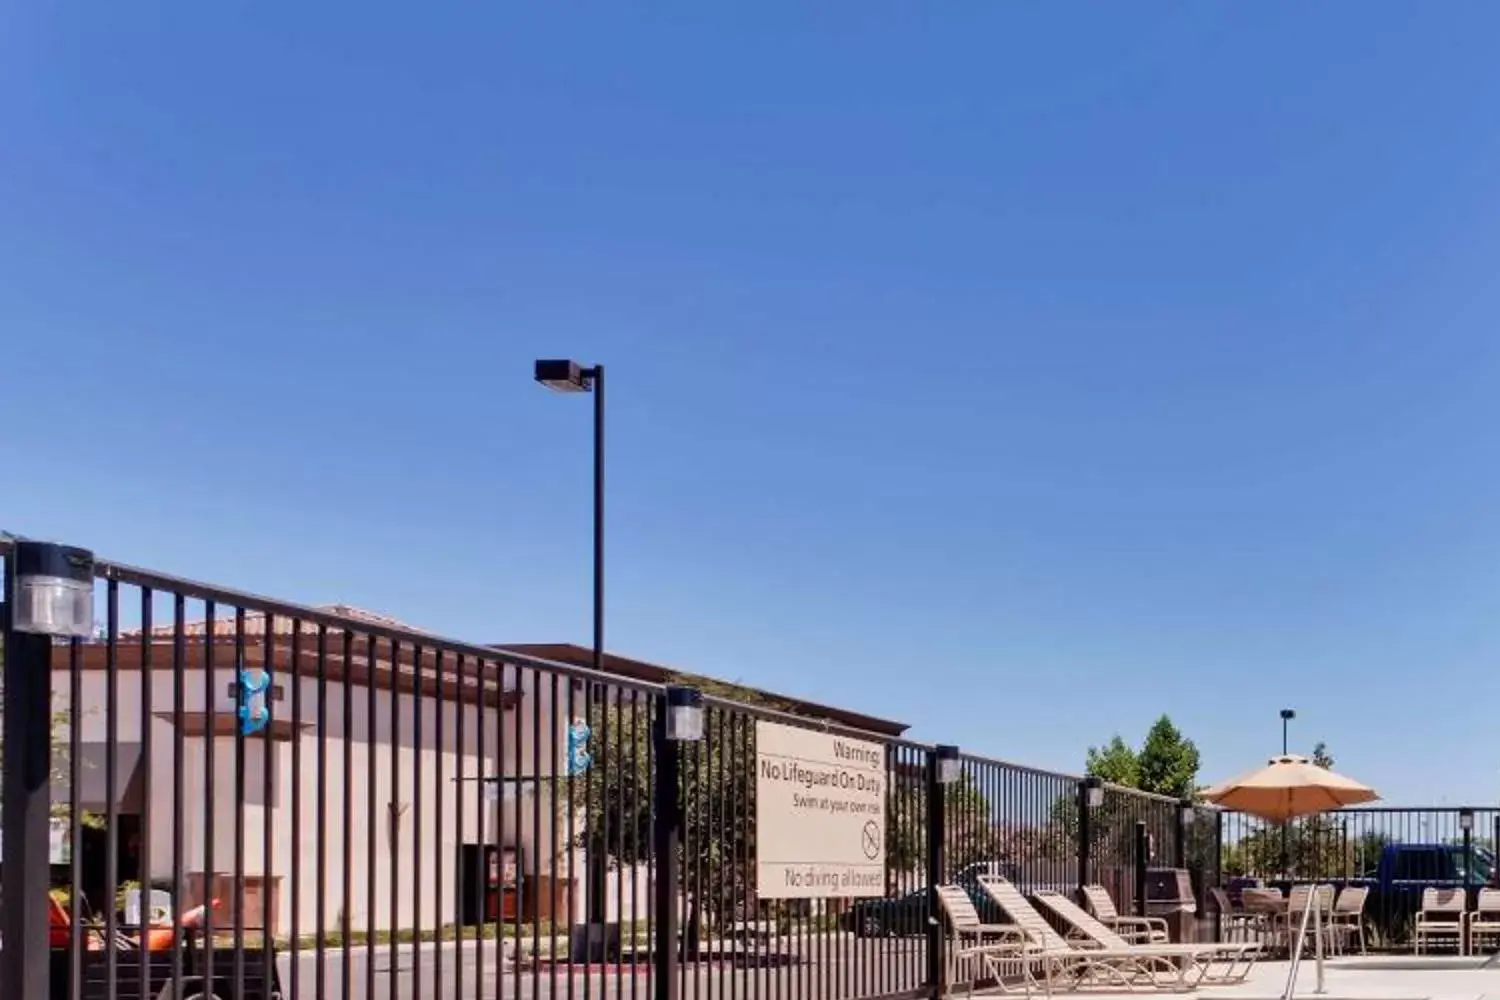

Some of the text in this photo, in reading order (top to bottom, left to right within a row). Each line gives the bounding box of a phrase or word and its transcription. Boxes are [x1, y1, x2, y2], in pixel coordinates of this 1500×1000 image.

[760, 759, 880, 798] No Lifeguard On Duty
[793, 792, 818, 808] Swim
[785, 866, 881, 892] No diving allowed
